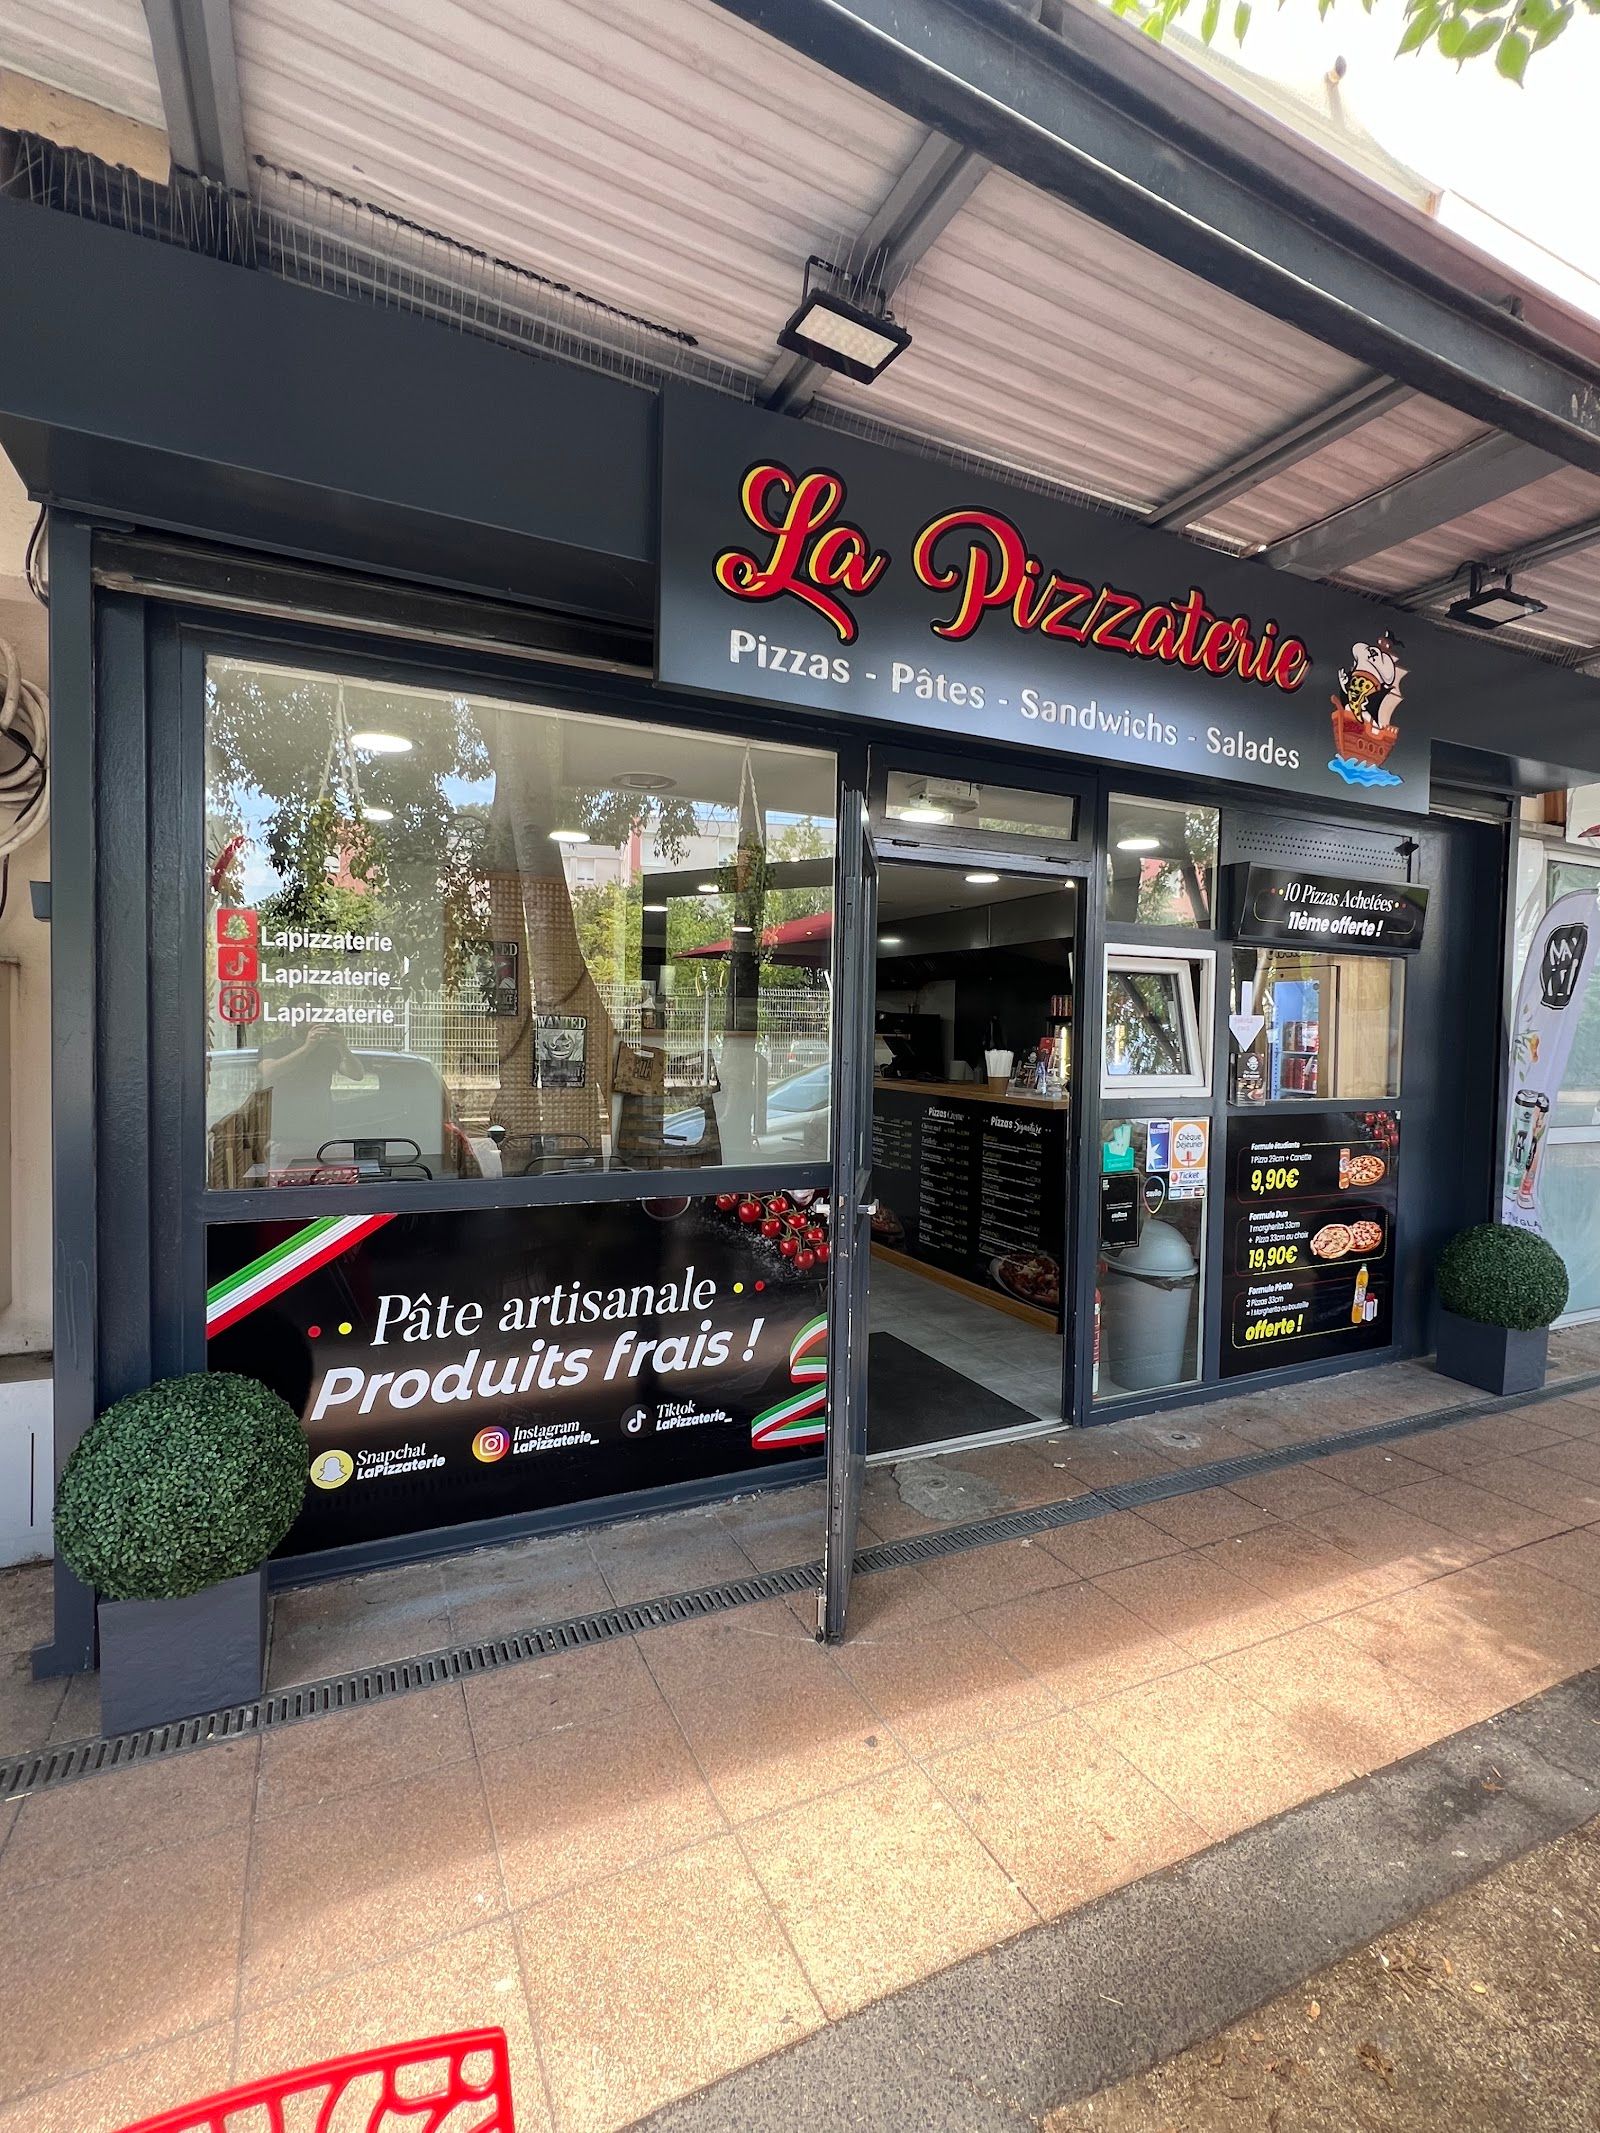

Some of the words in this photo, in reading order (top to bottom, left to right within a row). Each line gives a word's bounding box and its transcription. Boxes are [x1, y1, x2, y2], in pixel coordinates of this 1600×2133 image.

[715, 465, 886, 641] La
[912, 510, 1311, 690] Pizzaterie
[730, 629, 851, 684] Pizzas
[892, 661, 986, 710] Pâtes
[1021, 690, 1178, 746] Sandwichs
[1206, 727, 1300, 770] Salades
[1283, 882, 1300, 902] 10
[1300, 886, 1339, 907] Pizzas
[1340, 889, 1393, 912] Achetées
[1287, 912, 1329, 932] 11ème
[1330, 917, 1374, 936] offerte
[261, 926, 392, 952] Lapizzaterie
[537, 1017, 587, 1030] WANTED
[928, 1107, 947, 1119] Pizzas
[990, 1116, 1013, 1129] Pizzas
[1251, 1168, 1300, 1195] 9,90€
[1249, 1211, 1275, 1221] Formule
[1275, 1210, 1289, 1219] Duo
[1248, 1246, 1298, 1271] 19,90€
[1248, 1284, 1275, 1296] Formule
[369, 1292, 483, 1347] Pâte
[498, 1266, 717, 1333] artisanale
[1245, 1318, 1295, 1341] offerte
[1296, 1314, 1304, 1332] !
[309, 1337, 598, 1422] Produits
[603, 1319, 734, 1381] frais
[740, 1318, 765, 1362] !
[656, 1400, 696, 1419] Tiktok
[513, 1419, 580, 1444] Instagram
[356, 1442, 426, 1467] Snapchat
[356, 1454, 446, 1481] LaPizzaterie
